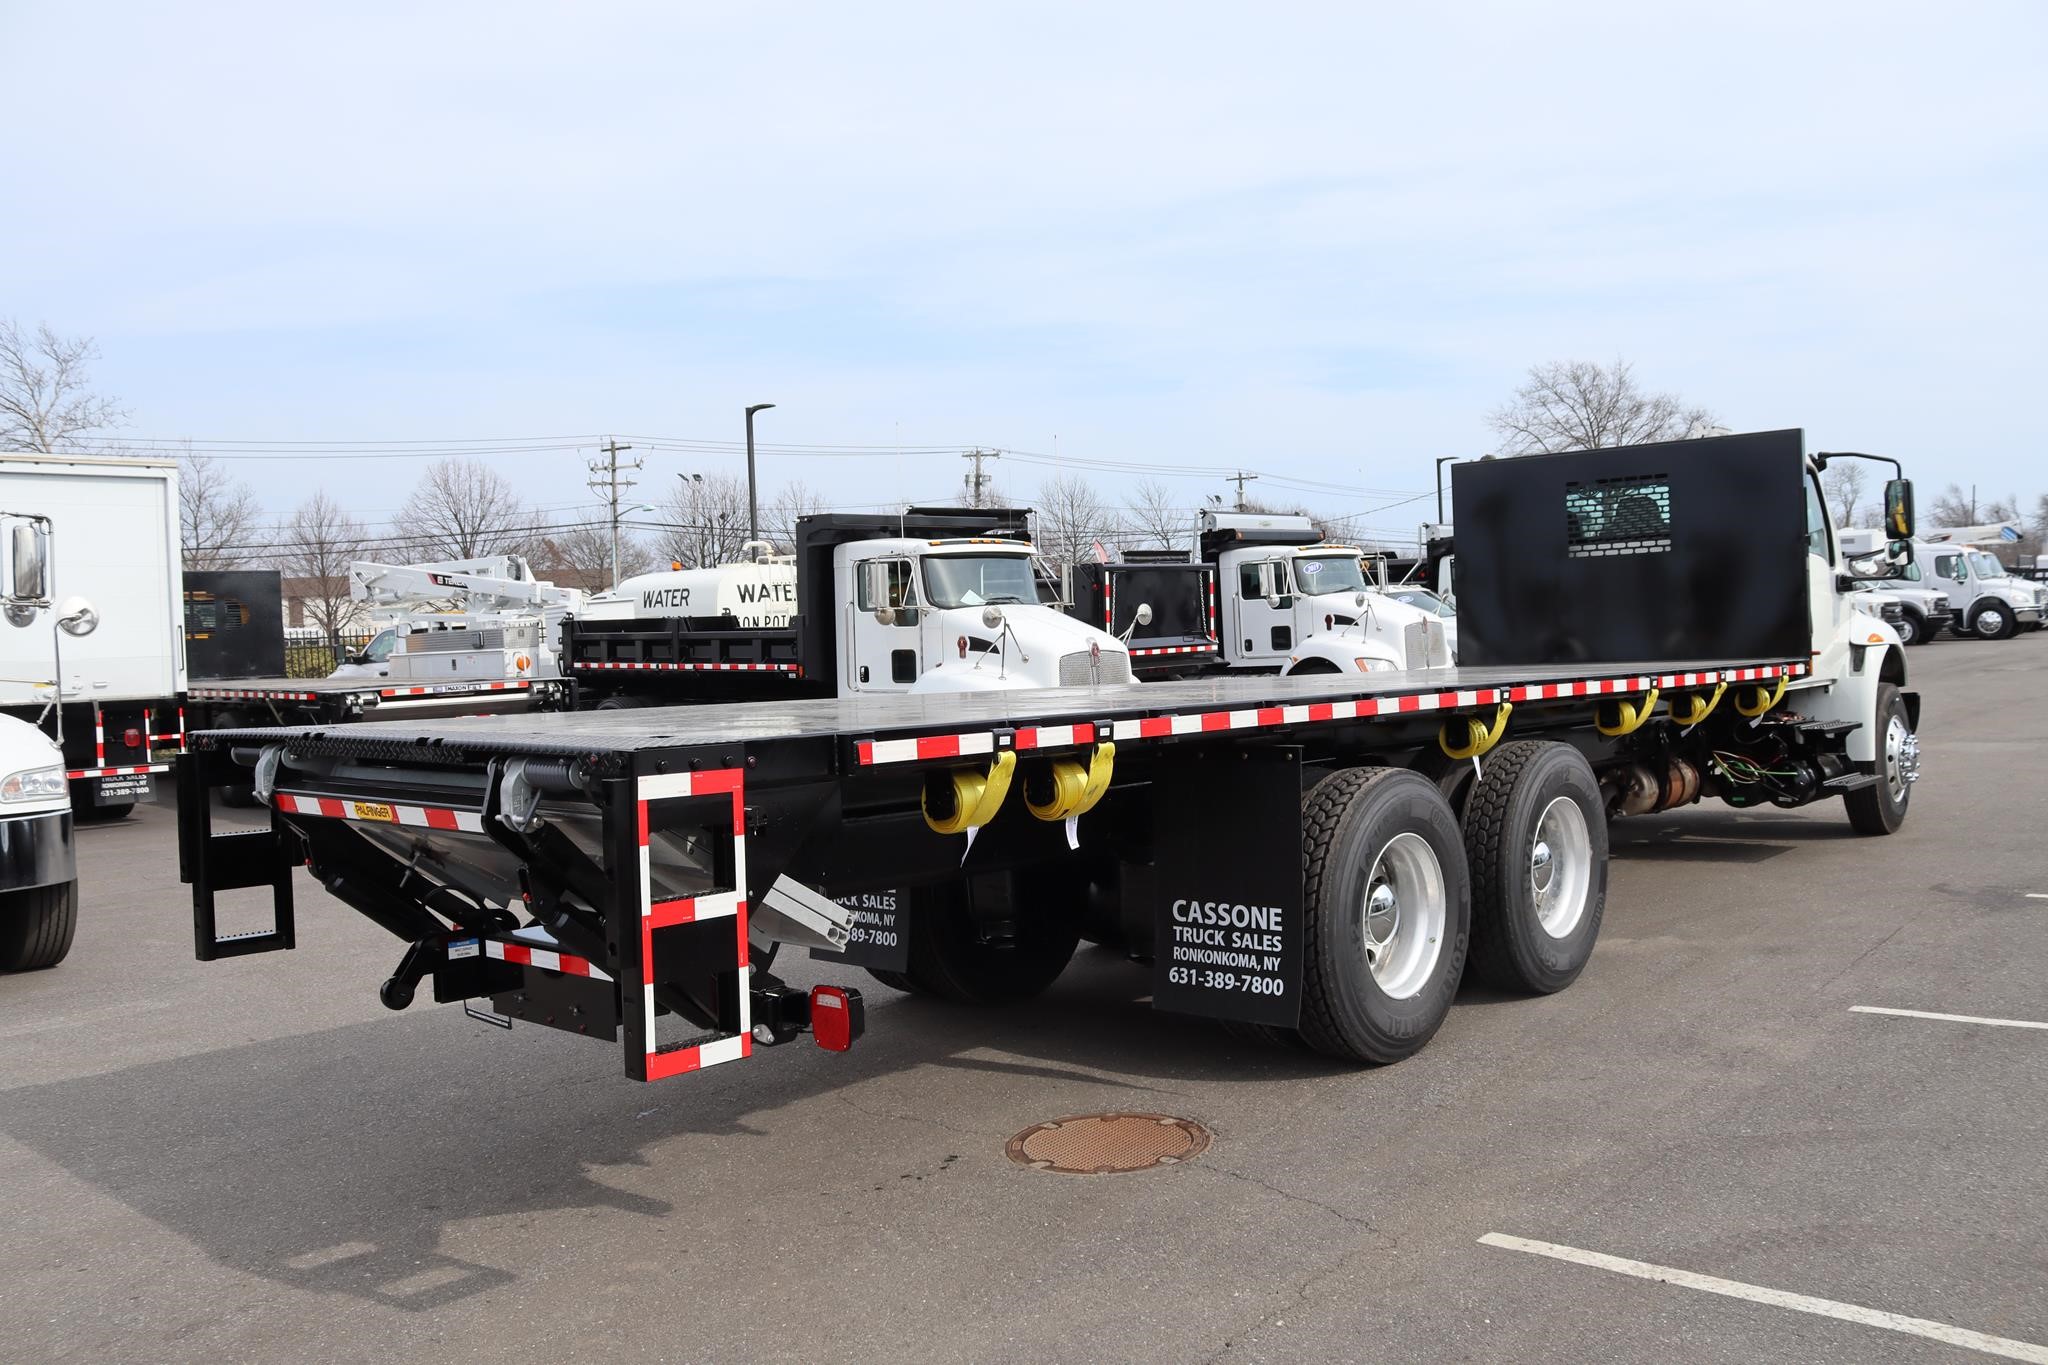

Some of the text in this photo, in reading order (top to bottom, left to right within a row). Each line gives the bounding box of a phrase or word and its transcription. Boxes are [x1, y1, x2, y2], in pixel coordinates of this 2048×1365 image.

[642, 587, 690, 608] WATER
[736, 583, 797, 604] WATE
[738, 615, 760, 627] ON
[101, 787, 149, 796] 631-389-7800
[355, 804, 391, 818] PALFINGER
[862, 893, 896, 911] SALES
[883, 913, 896, 927] NY
[1172, 899, 1283, 932] CASSONE
[1172, 925, 1283, 953] TRUCK SALES
[1173, 946, 1281, 972] RONKONKOMA, NY
[1168, 966, 1284, 997] 631-389-7800
